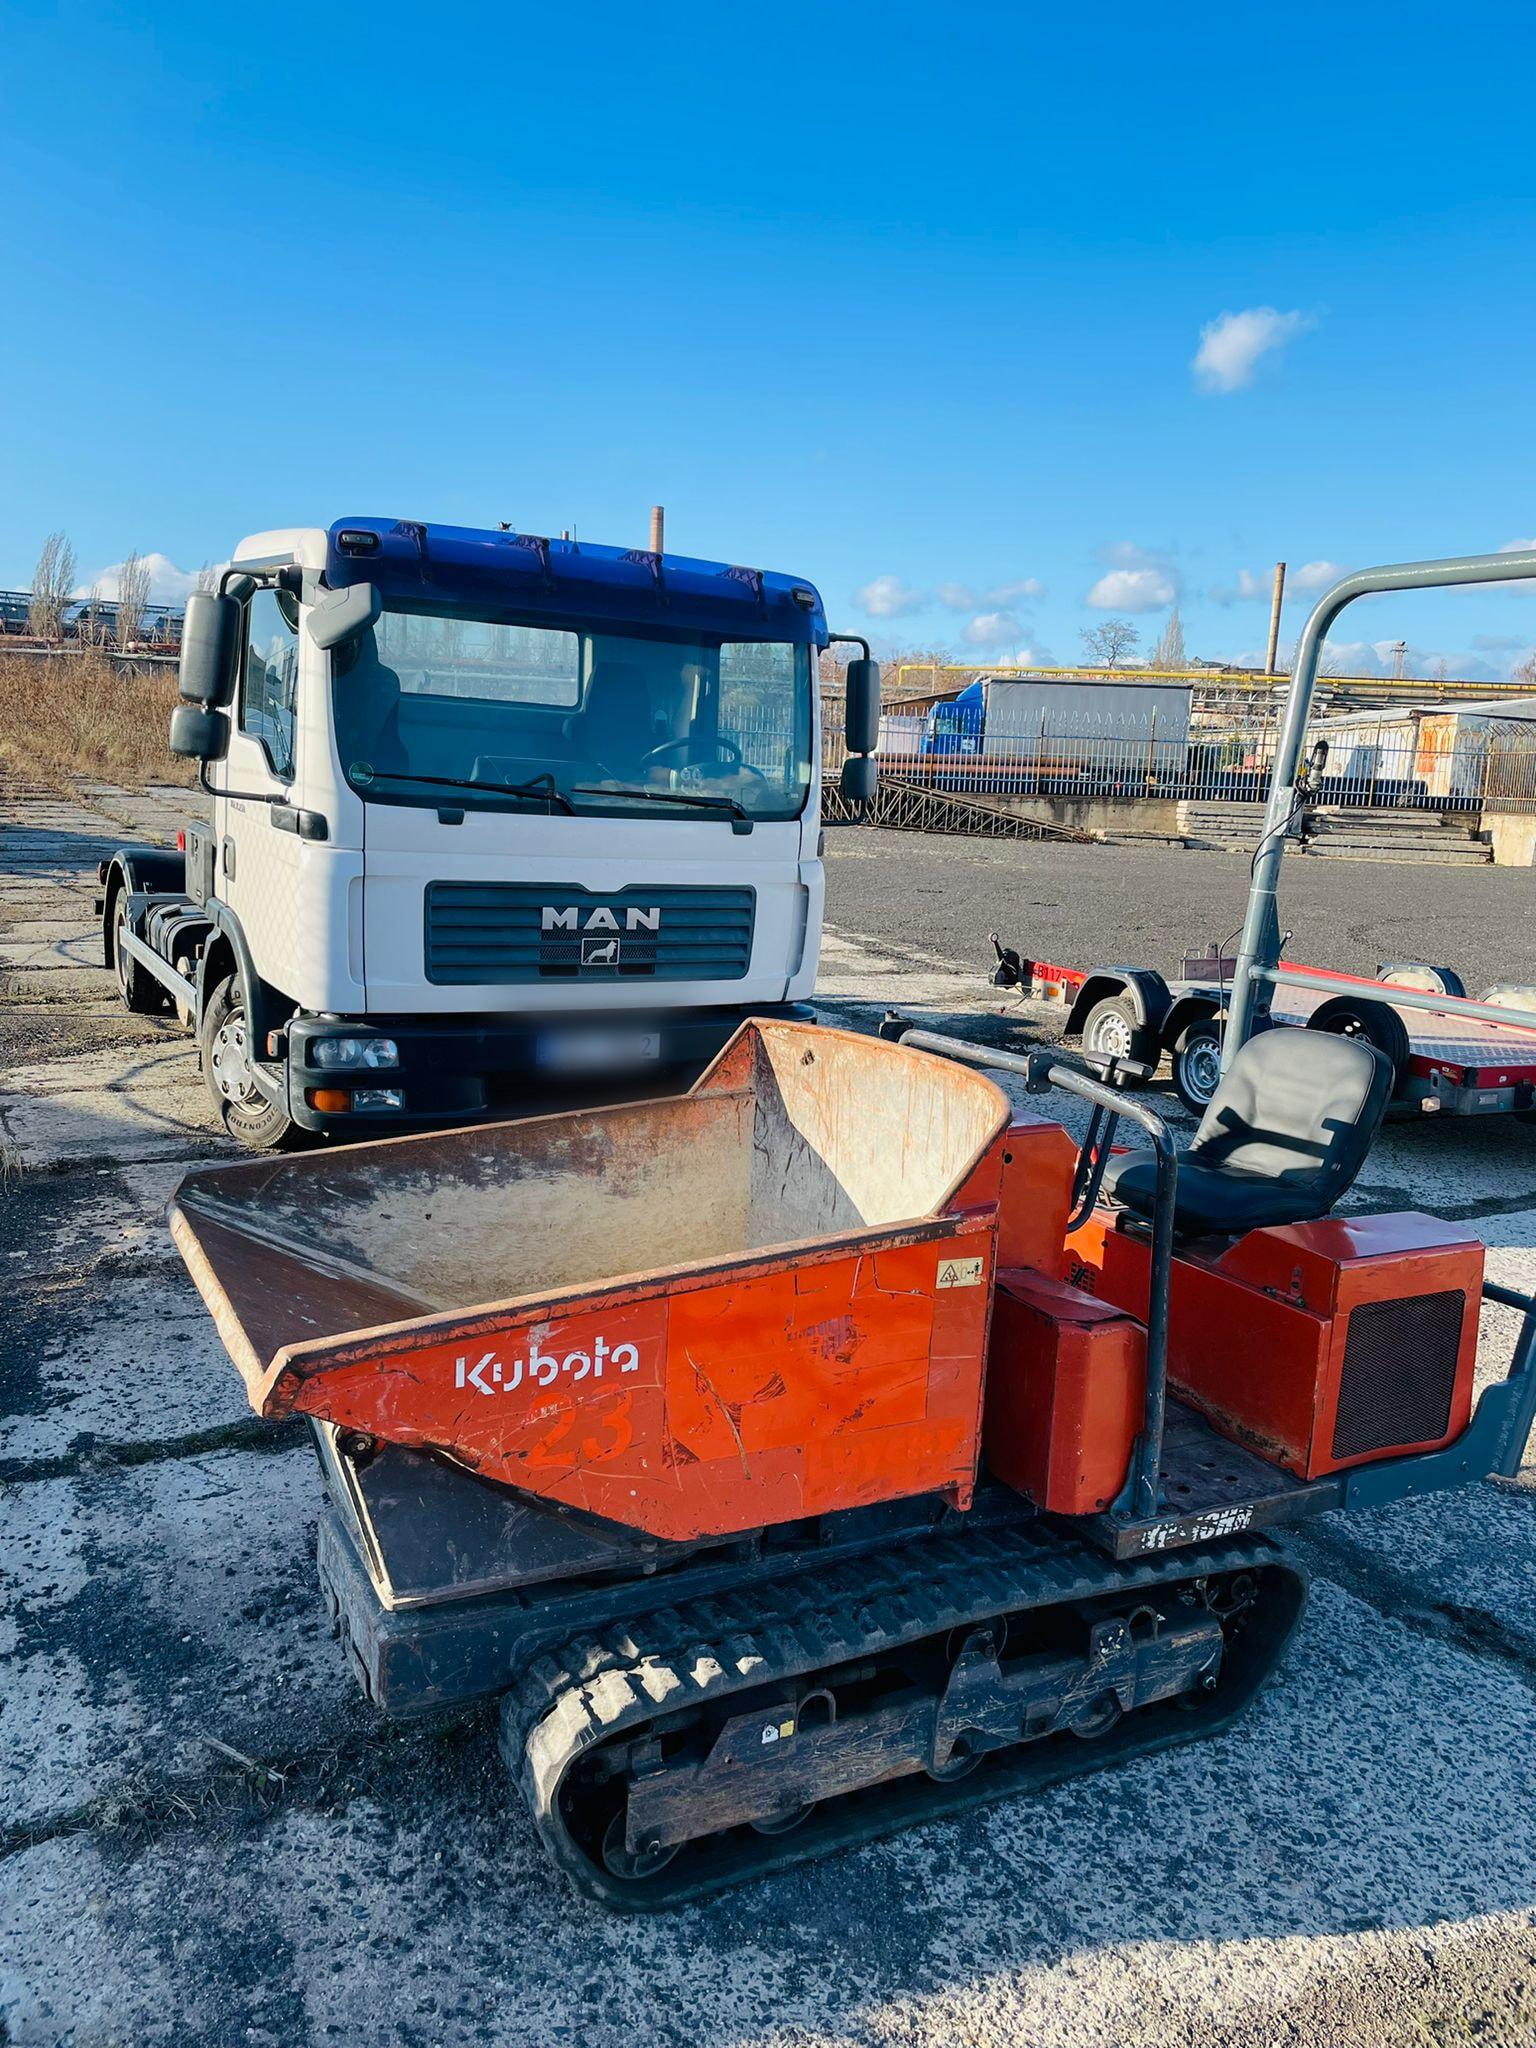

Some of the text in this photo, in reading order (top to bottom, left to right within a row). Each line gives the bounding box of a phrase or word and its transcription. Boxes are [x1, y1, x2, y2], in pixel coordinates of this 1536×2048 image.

[541, 906, 660, 930] MAN
[455, 1336, 639, 1396] Kubota
[522, 1382, 633, 1471] 23
